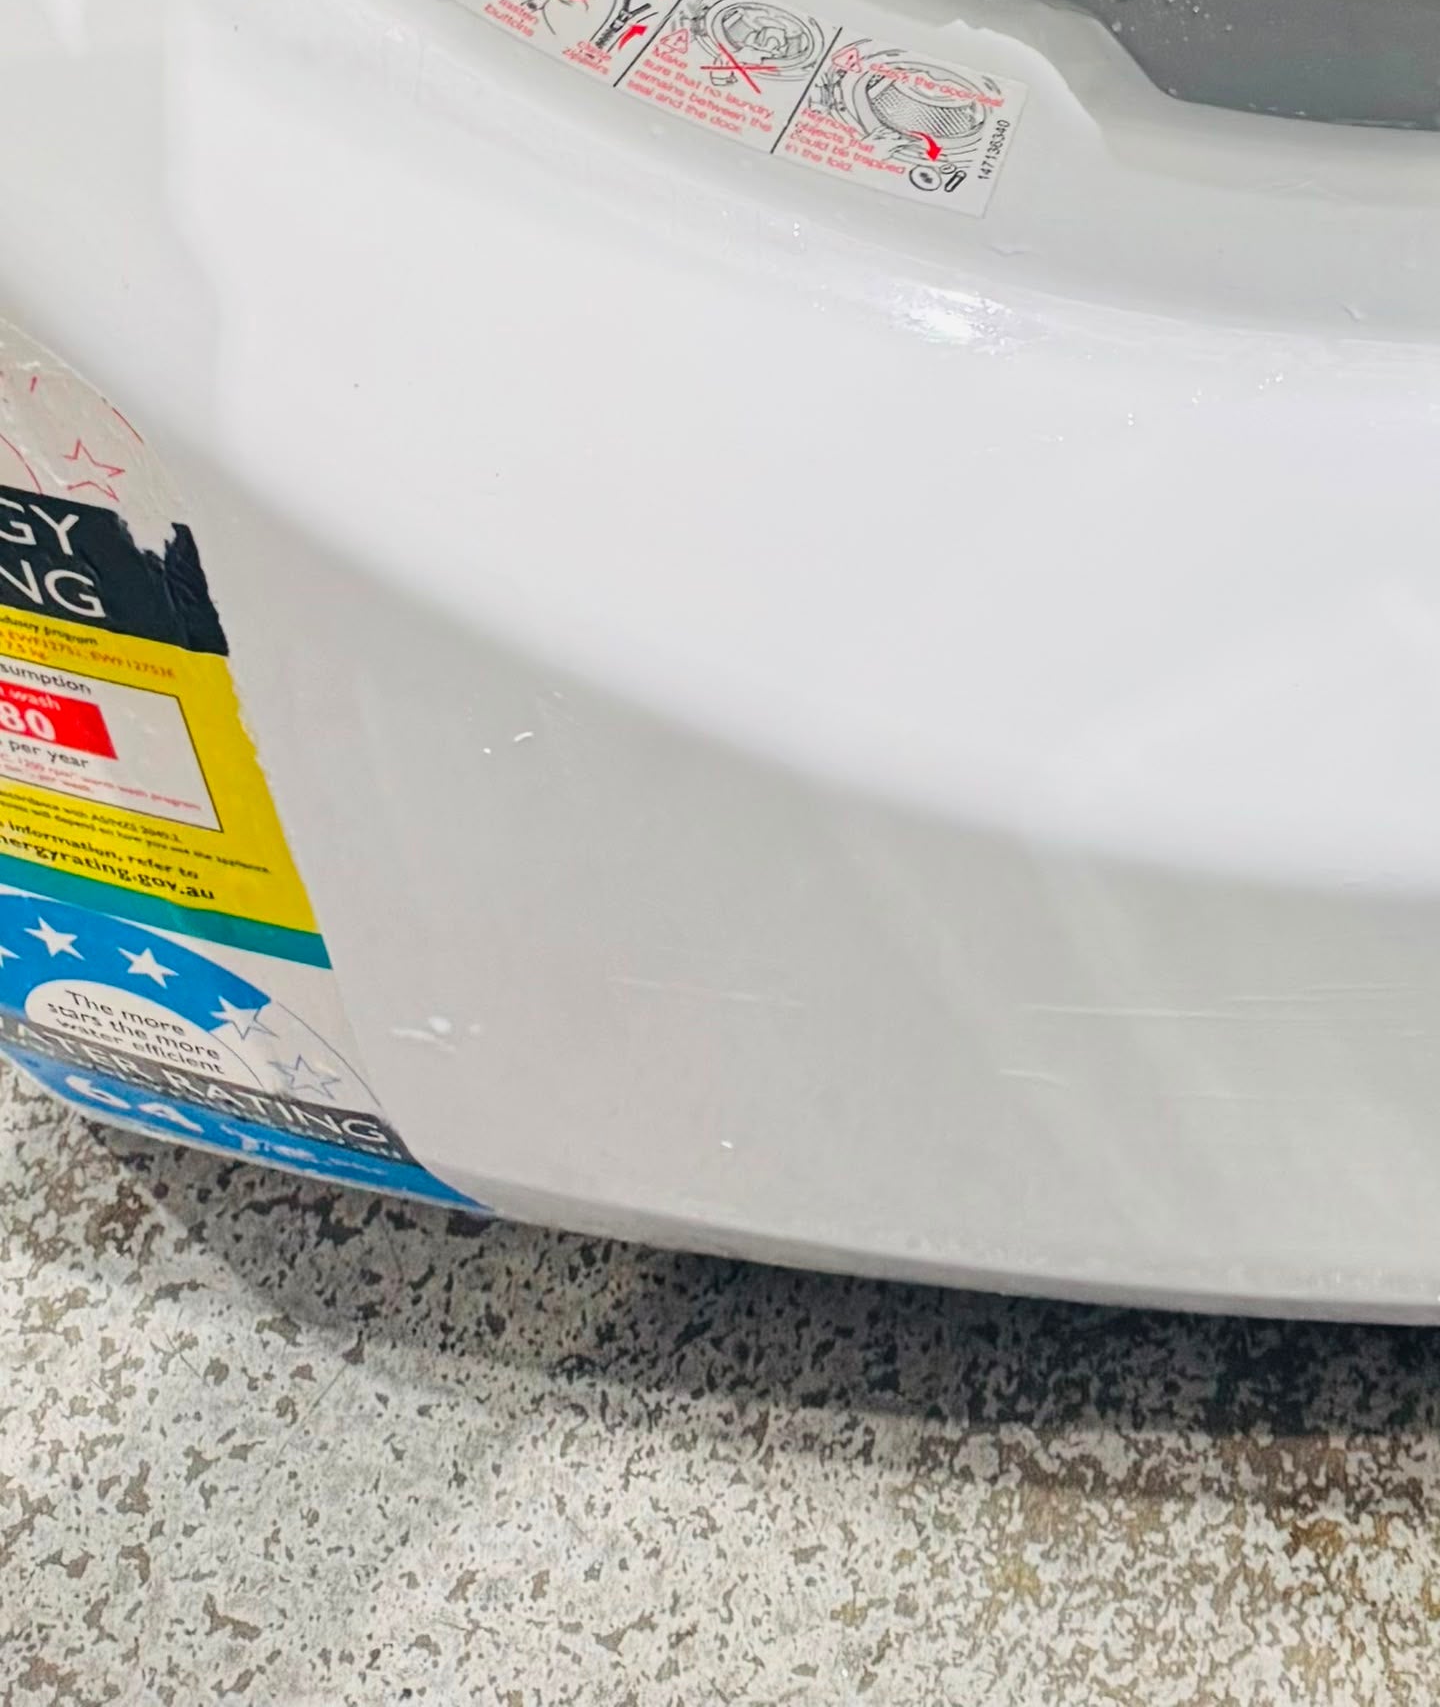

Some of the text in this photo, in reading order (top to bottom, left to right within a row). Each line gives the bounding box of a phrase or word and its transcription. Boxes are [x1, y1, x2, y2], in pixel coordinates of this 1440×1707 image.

[634, 69, 772, 132] remains between the
[655, 93, 684, 109] and
[685, 104, 708, 120] the
[675, 72, 700, 90] that
[704, 85, 722, 98] no
[726, 92, 774, 119] laundry
[801, 148, 822, 163] the
[832, 145, 849, 157] be
[853, 153, 906, 175] trapped
[849, 138, 874, 153] that
[8, 739, 90, 769] per year
[10, 818, 200, 880] information, refer to
[47, 1001, 221, 1062] stars the more
[64, 988, 187, 1038] The more
[131, 1040, 226, 1076] efficient
[0, 1015, 389, 1144] ATER RATING
